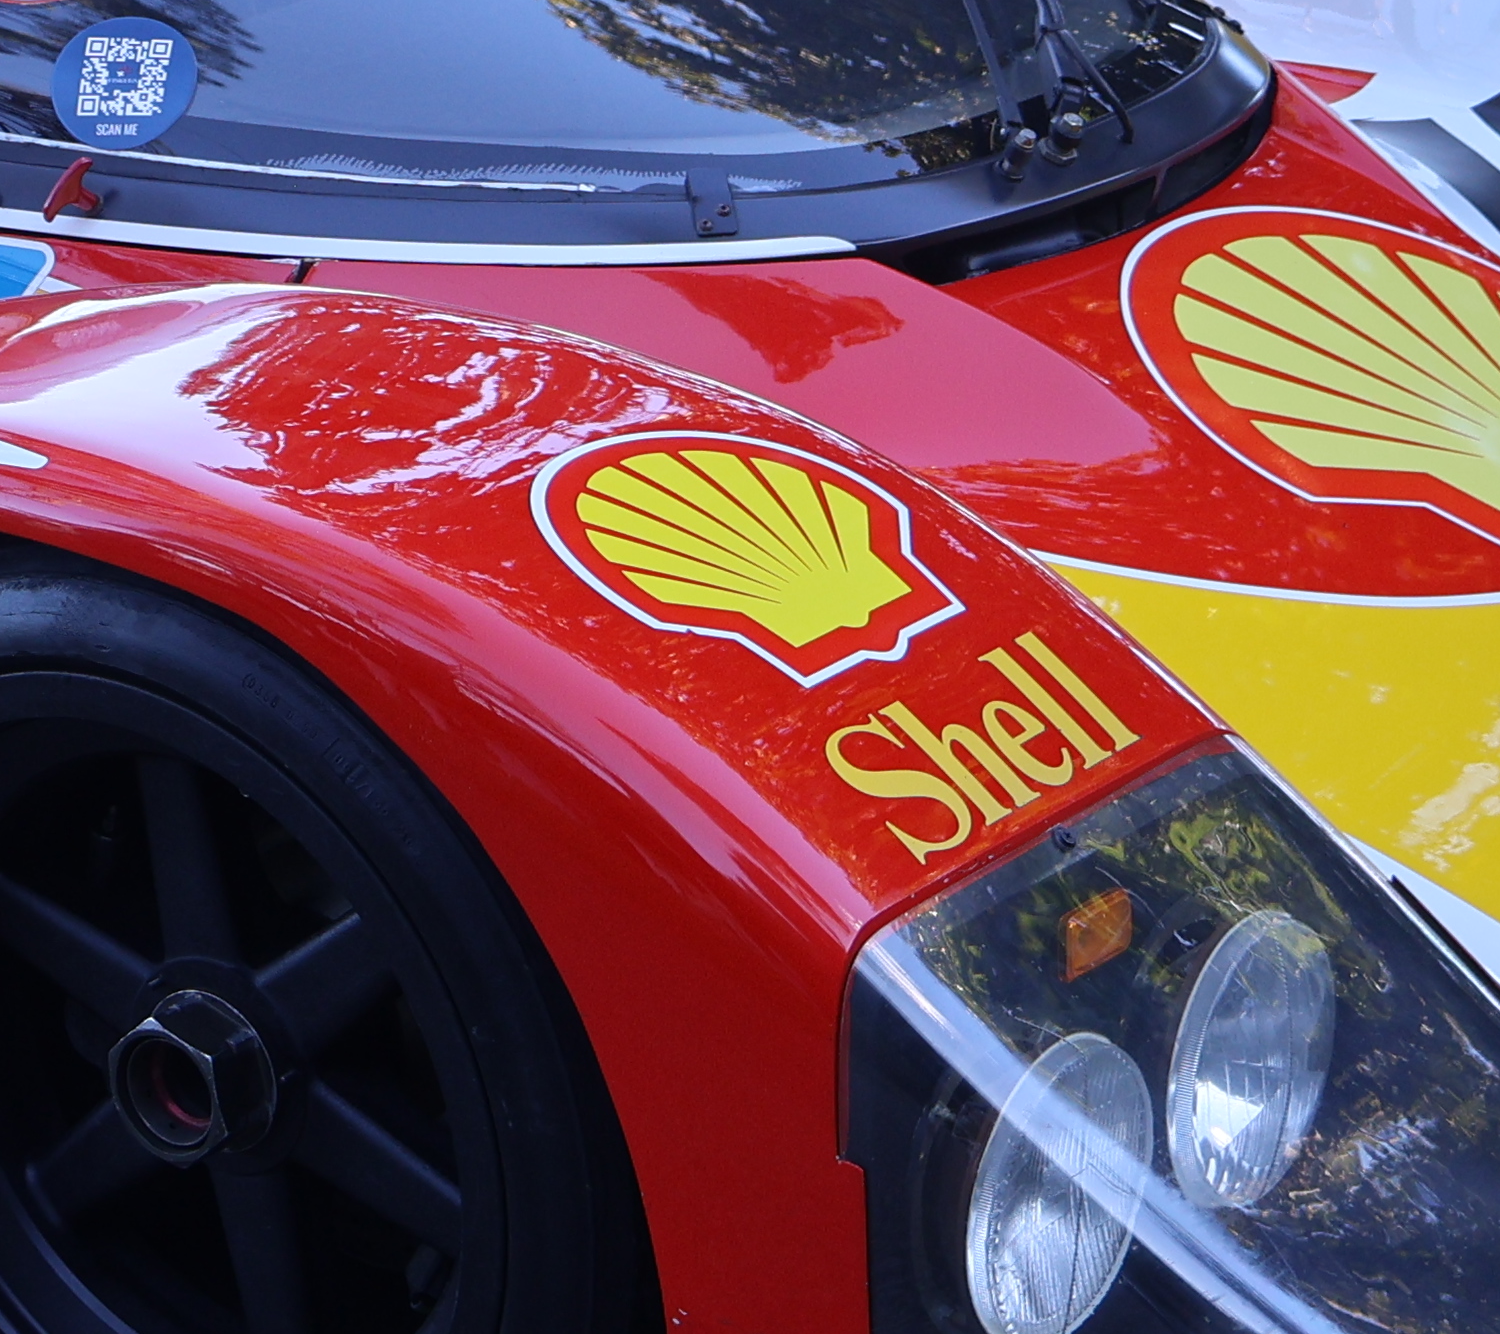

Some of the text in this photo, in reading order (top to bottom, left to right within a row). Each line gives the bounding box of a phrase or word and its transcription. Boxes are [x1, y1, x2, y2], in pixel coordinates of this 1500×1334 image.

[96, 123, 139, 136] SCAN ME
[824, 631, 1142, 866] Shell
